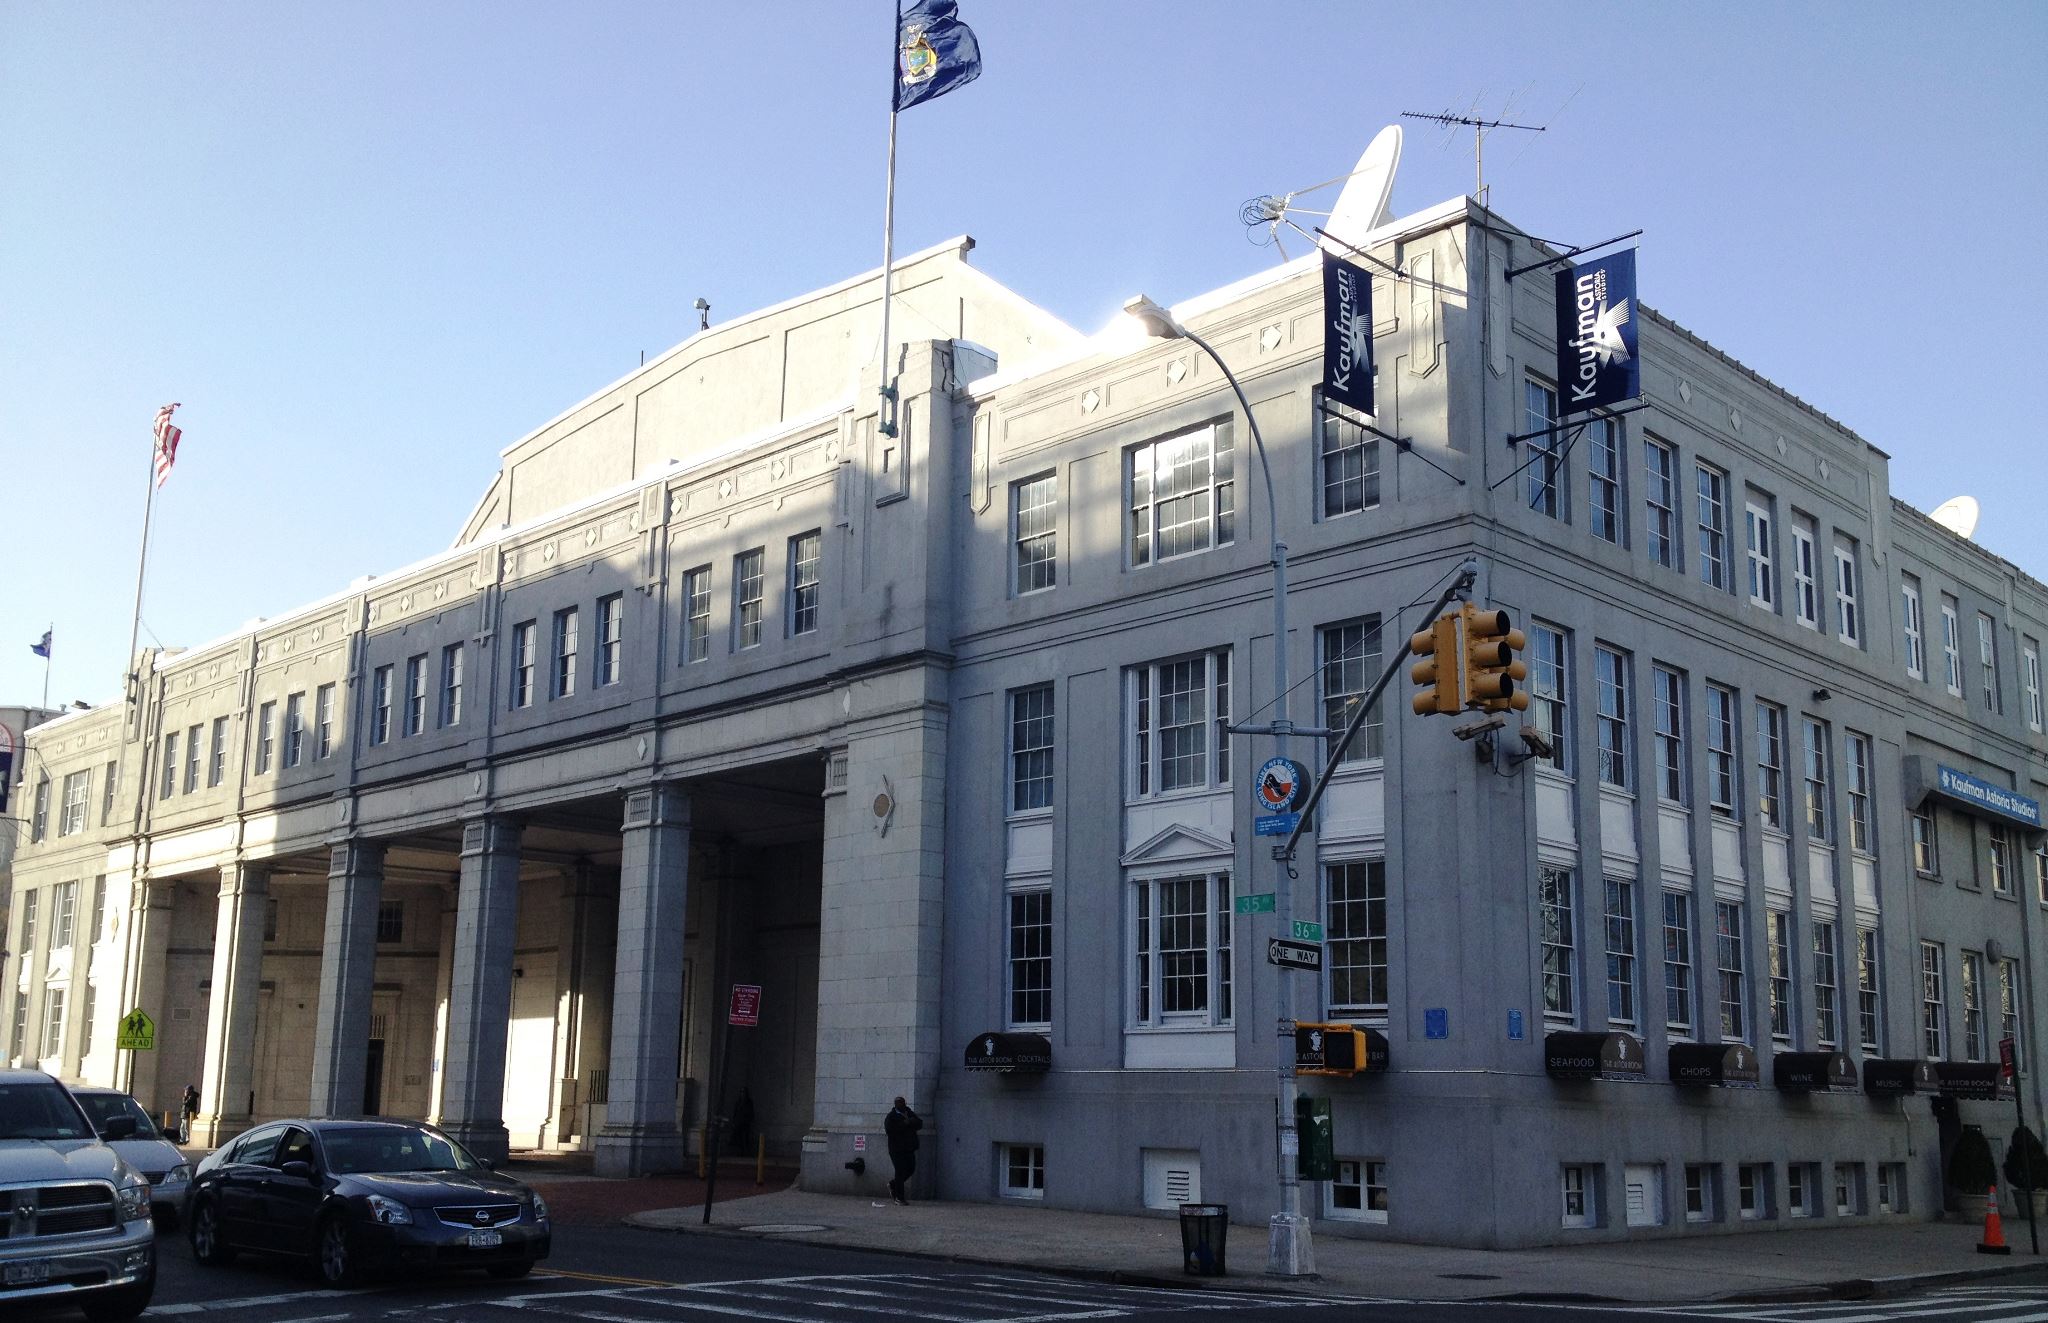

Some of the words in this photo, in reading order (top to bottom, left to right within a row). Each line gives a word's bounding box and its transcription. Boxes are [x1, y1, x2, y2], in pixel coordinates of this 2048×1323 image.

[1332, 268, 1353, 392] Kaufman
[1568, 273, 1597, 402] Kaufman
[1268, 759, 1284, 768] NEW
[1285, 762, 1298, 778] YORK
[1257, 787, 1268, 807] LONG
[1267, 799, 1290, 810] ISLAND
[1951, 774, 1985, 801] Kaufman
[1986, 788, 2010, 809] Astoria
[2011, 798, 2036, 819] Studios
[1242, 897, 1260, 912] 35
[1295, 922, 1310, 938] 36
[1311, 924, 1317, 932] ST
[1271, 946, 1289, 959] ONE
[1297, 950, 1315, 963] WAY
[121, 1039, 149, 1047] AHEAD
[1017, 1054, 1051, 1064] COCKTAILS
[1549, 1057, 1595, 1067] SEAFOOD
[1680, 1067, 1711, 1076] CHOPS
[1791, 1073, 1814, 1082] WINE
[1875, 1080, 1903, 1088] MUSIC
[1971, 1079, 1995, 1087] ROOM
